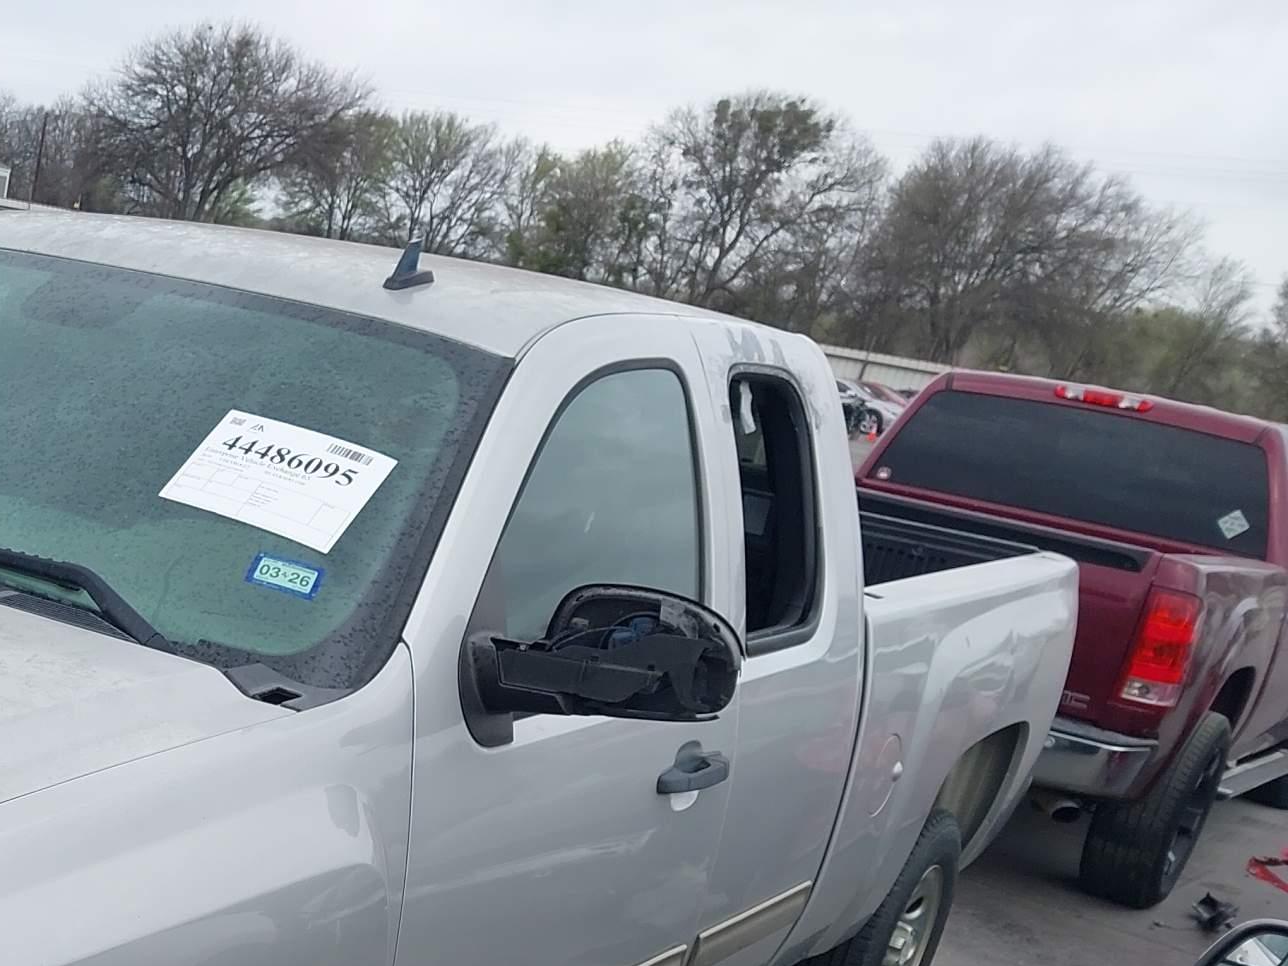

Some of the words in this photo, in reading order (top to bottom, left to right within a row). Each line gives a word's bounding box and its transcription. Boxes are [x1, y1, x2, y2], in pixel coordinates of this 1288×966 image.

[221, 435, 360, 487] 44486095
[259, 564, 281, 578] 03
[288, 572, 311, 587] 26
